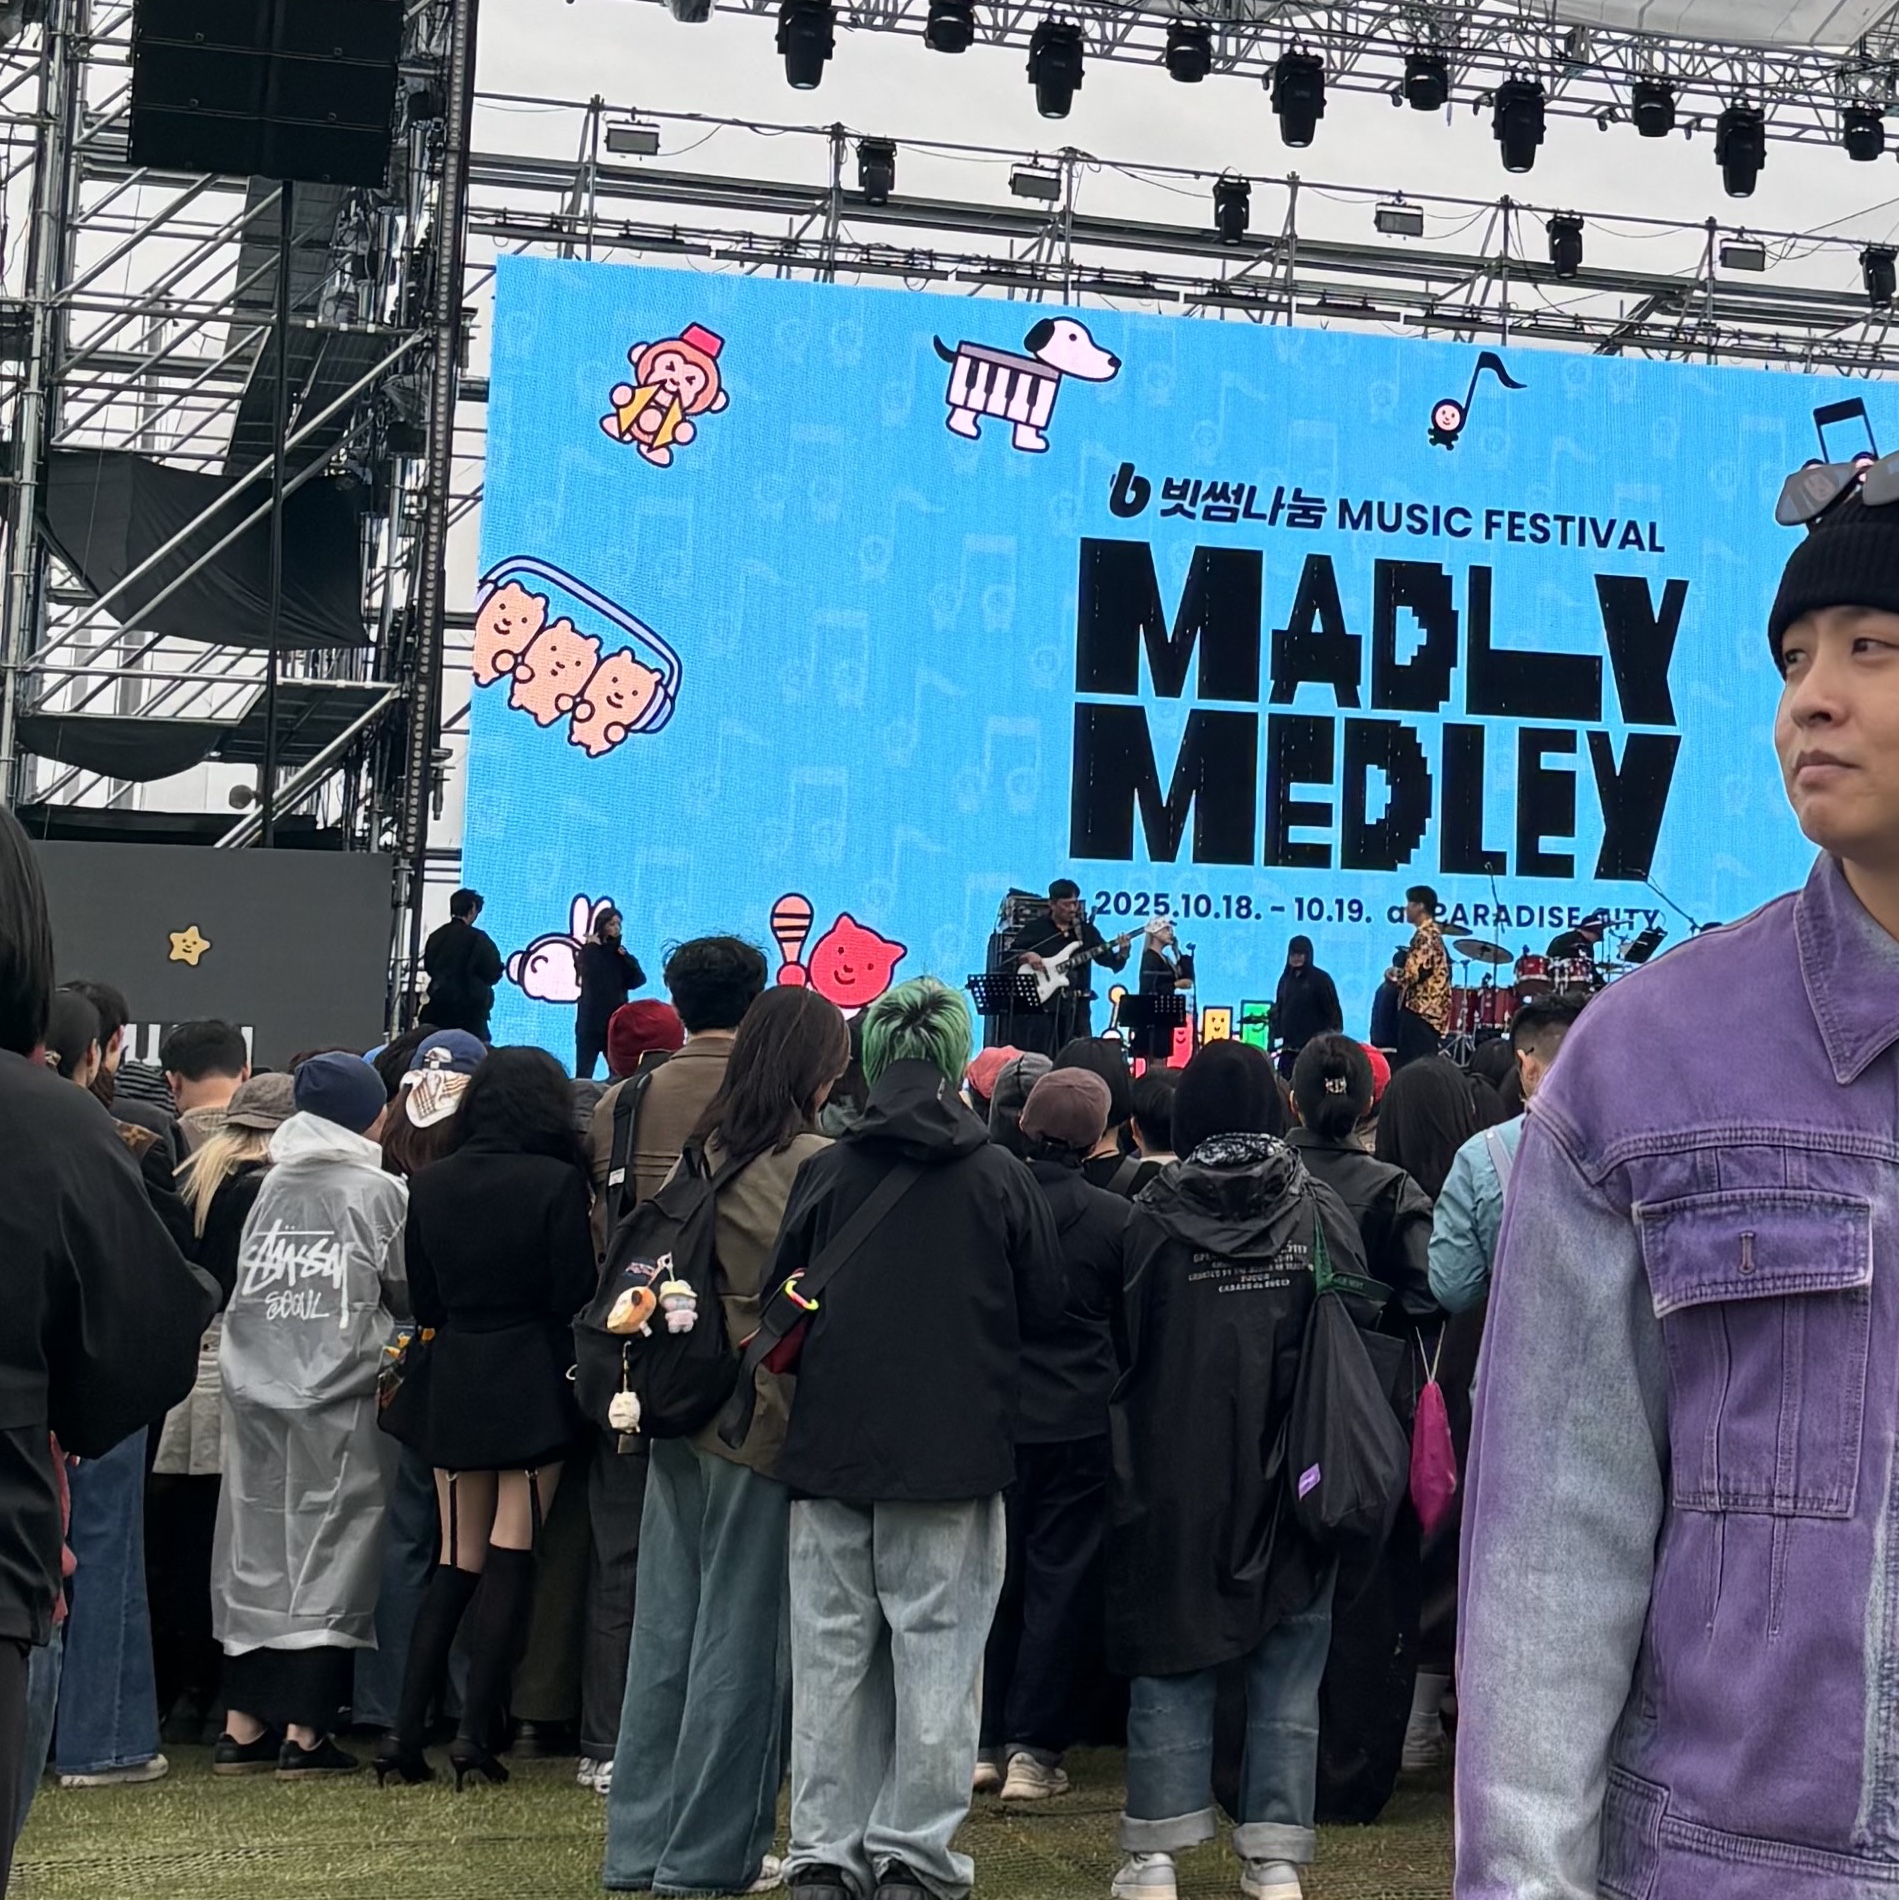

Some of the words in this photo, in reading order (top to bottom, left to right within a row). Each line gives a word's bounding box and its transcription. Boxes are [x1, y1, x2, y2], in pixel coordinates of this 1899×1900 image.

[1160, 477, 1328, 530] 빗썸나눔
[1338, 498, 1474, 538] MUSIC
[1484, 508, 1666, 553] FESTIVAL
[1074, 537, 1690, 727] MADLY
[1069, 701, 1682, 881] MEDLEY
[1095, 891, 1262, 921] 2025.10.18.
[1294, 896, 1373, 924] 10.19.
